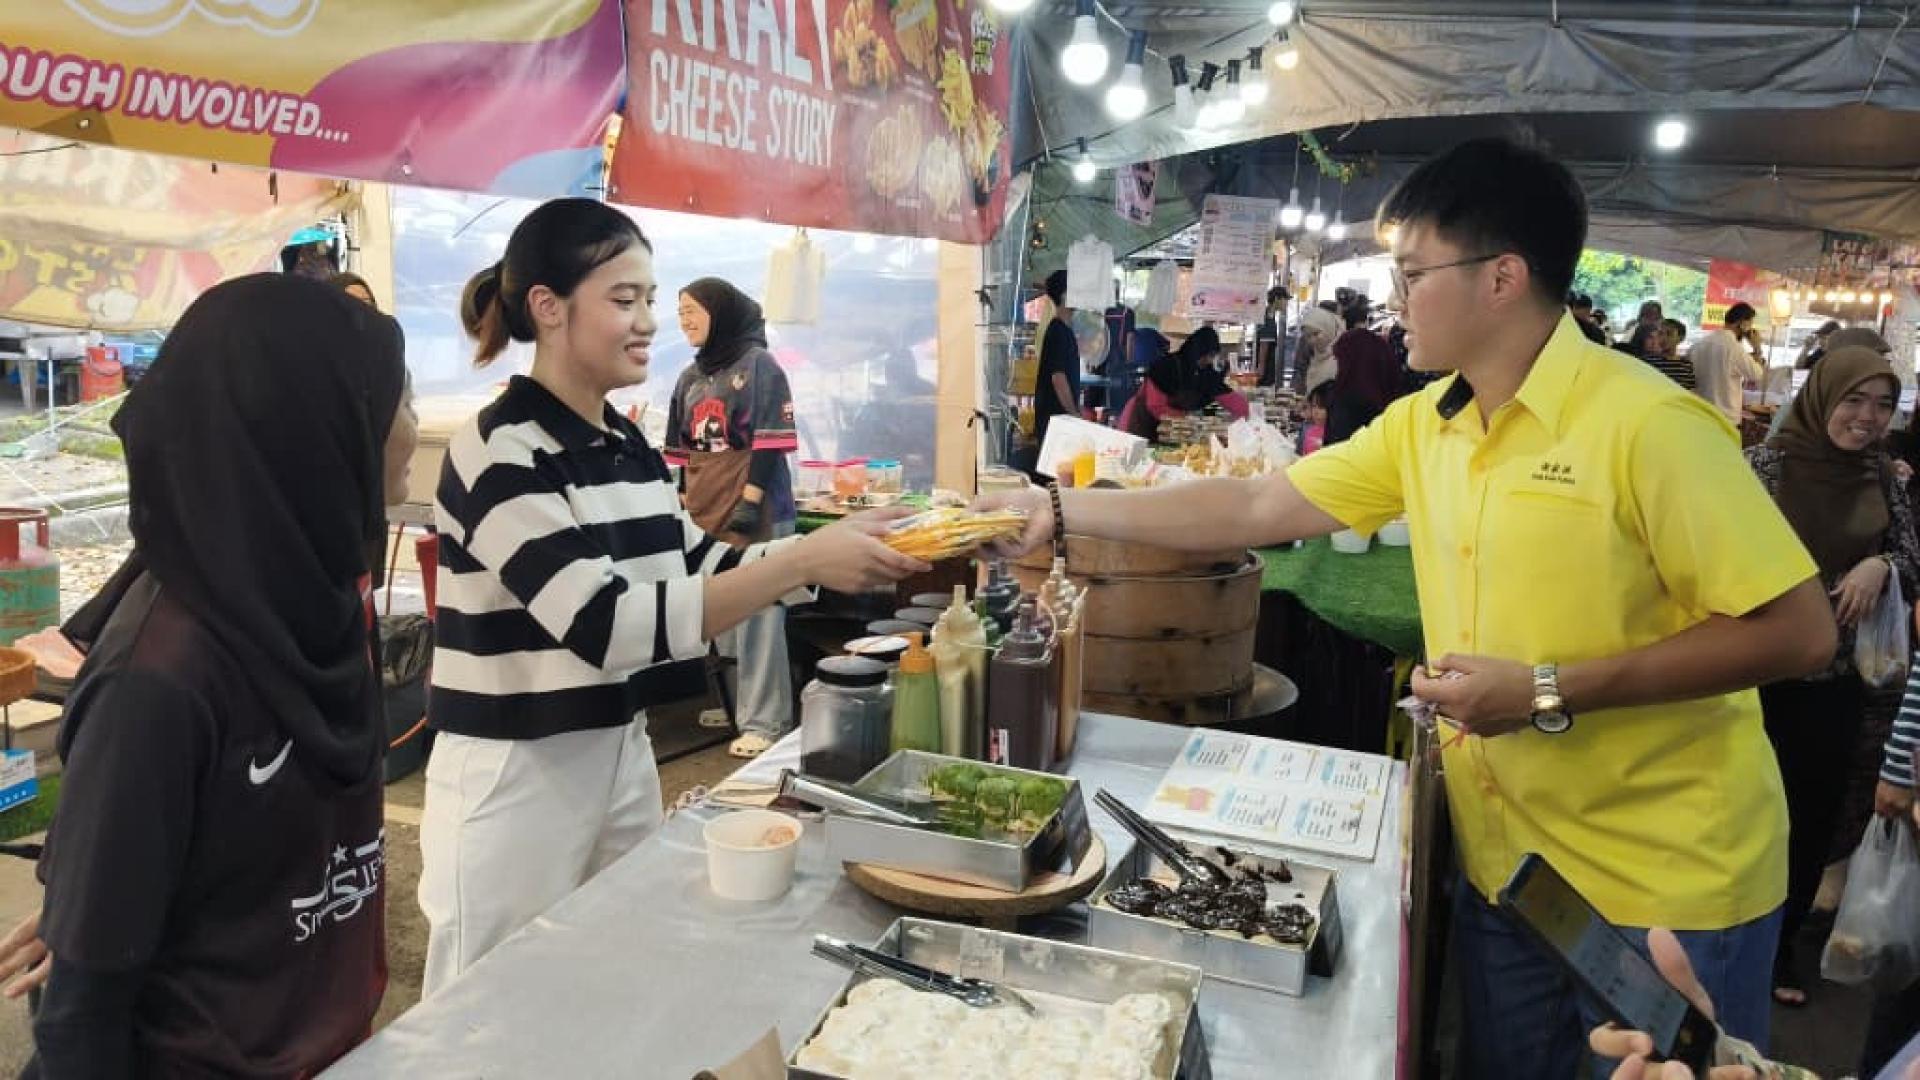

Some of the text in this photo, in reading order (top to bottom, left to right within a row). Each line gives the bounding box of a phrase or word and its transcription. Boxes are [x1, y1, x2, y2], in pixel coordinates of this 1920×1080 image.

[0, 53, 121, 108] UGH
[650, 49, 837, 169] CHEESE STORY
